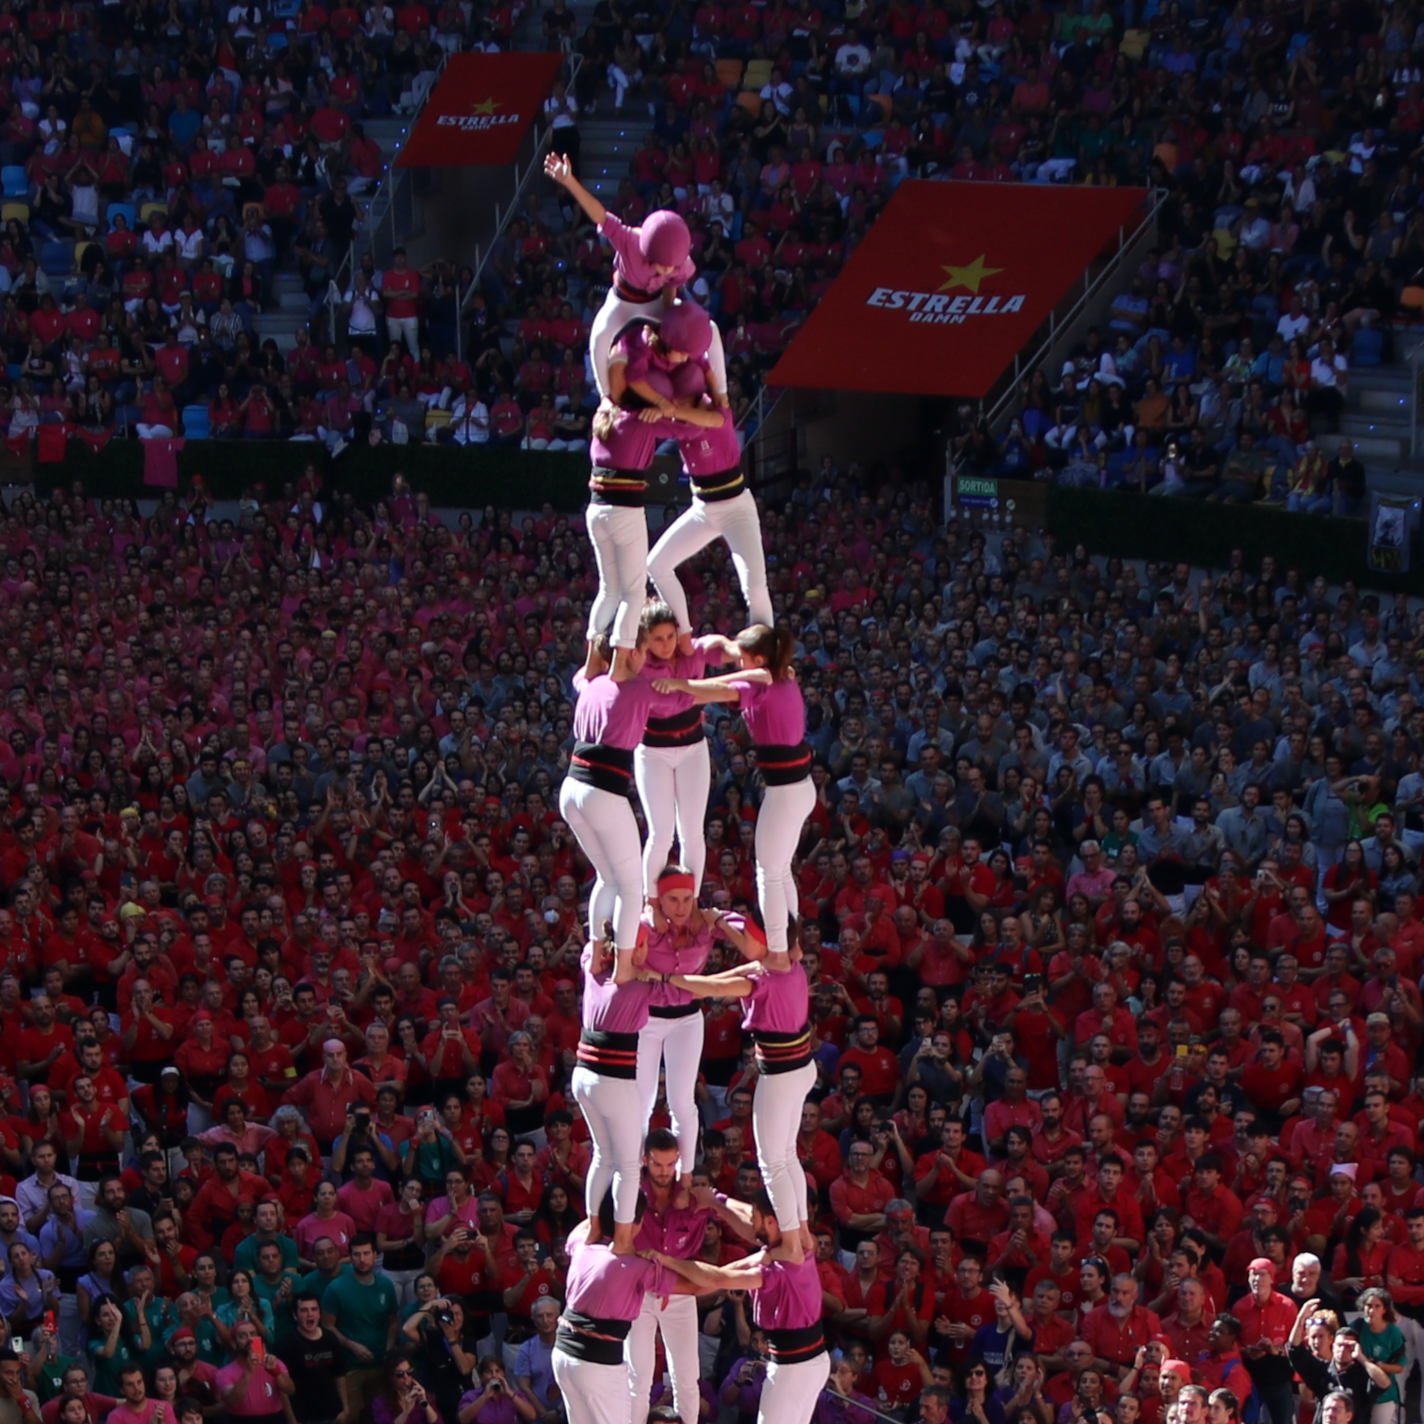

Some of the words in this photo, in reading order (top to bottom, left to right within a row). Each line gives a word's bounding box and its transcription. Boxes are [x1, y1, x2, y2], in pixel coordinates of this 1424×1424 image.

[436, 114, 520, 126] ESTRELLA
[866, 287, 1026, 315] ESTRELLA
[908, 312, 967, 324] DAMM
[959, 479, 996, 493] SORTIDA
